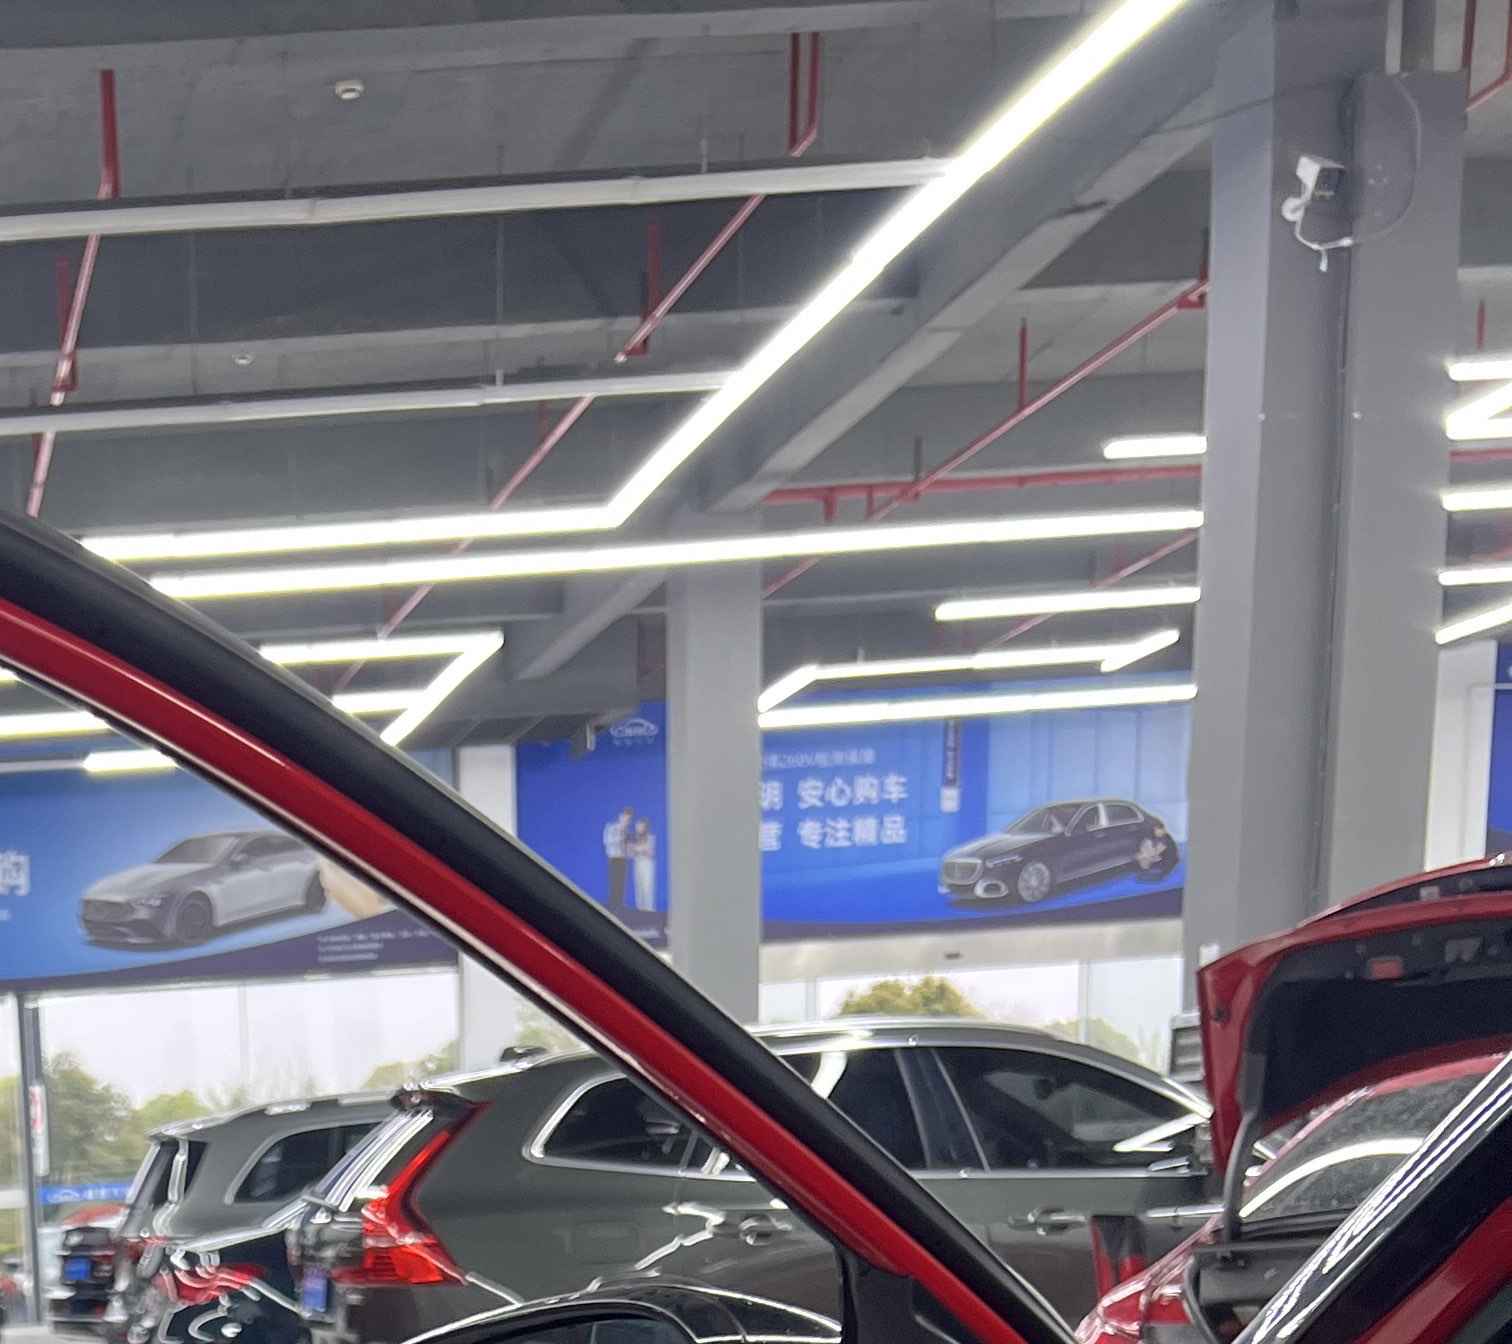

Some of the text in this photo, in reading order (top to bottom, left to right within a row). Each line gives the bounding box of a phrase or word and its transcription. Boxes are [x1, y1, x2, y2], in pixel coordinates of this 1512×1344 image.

[796, 772, 908, 810] 安心购车
[796, 813, 909, 849] 专注精品
